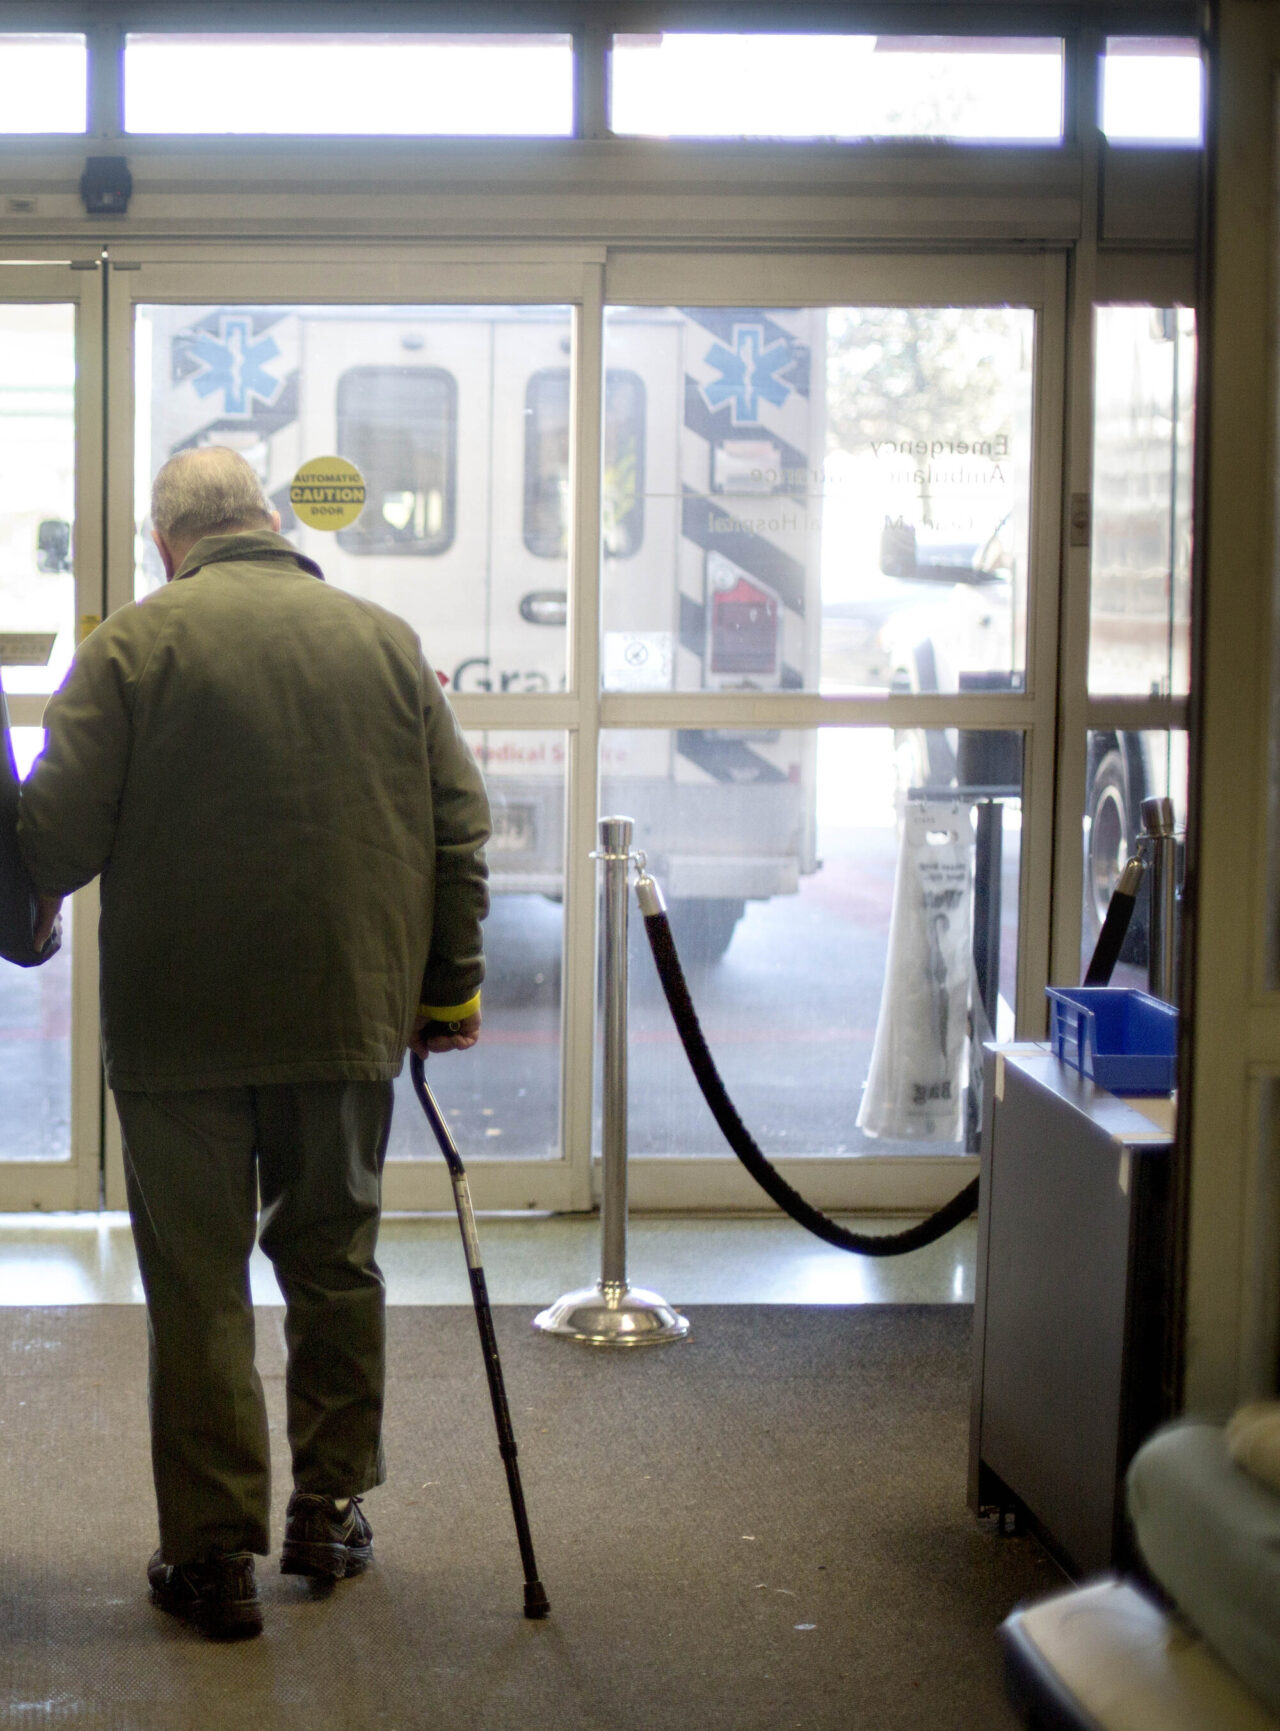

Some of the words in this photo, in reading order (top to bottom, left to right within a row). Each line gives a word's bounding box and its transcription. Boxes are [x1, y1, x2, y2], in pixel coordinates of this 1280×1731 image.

[294, 473, 362, 483] AUTOMATIC
[291, 488, 365, 502] CAUTION
[311, 506, 345, 516] DOOR
